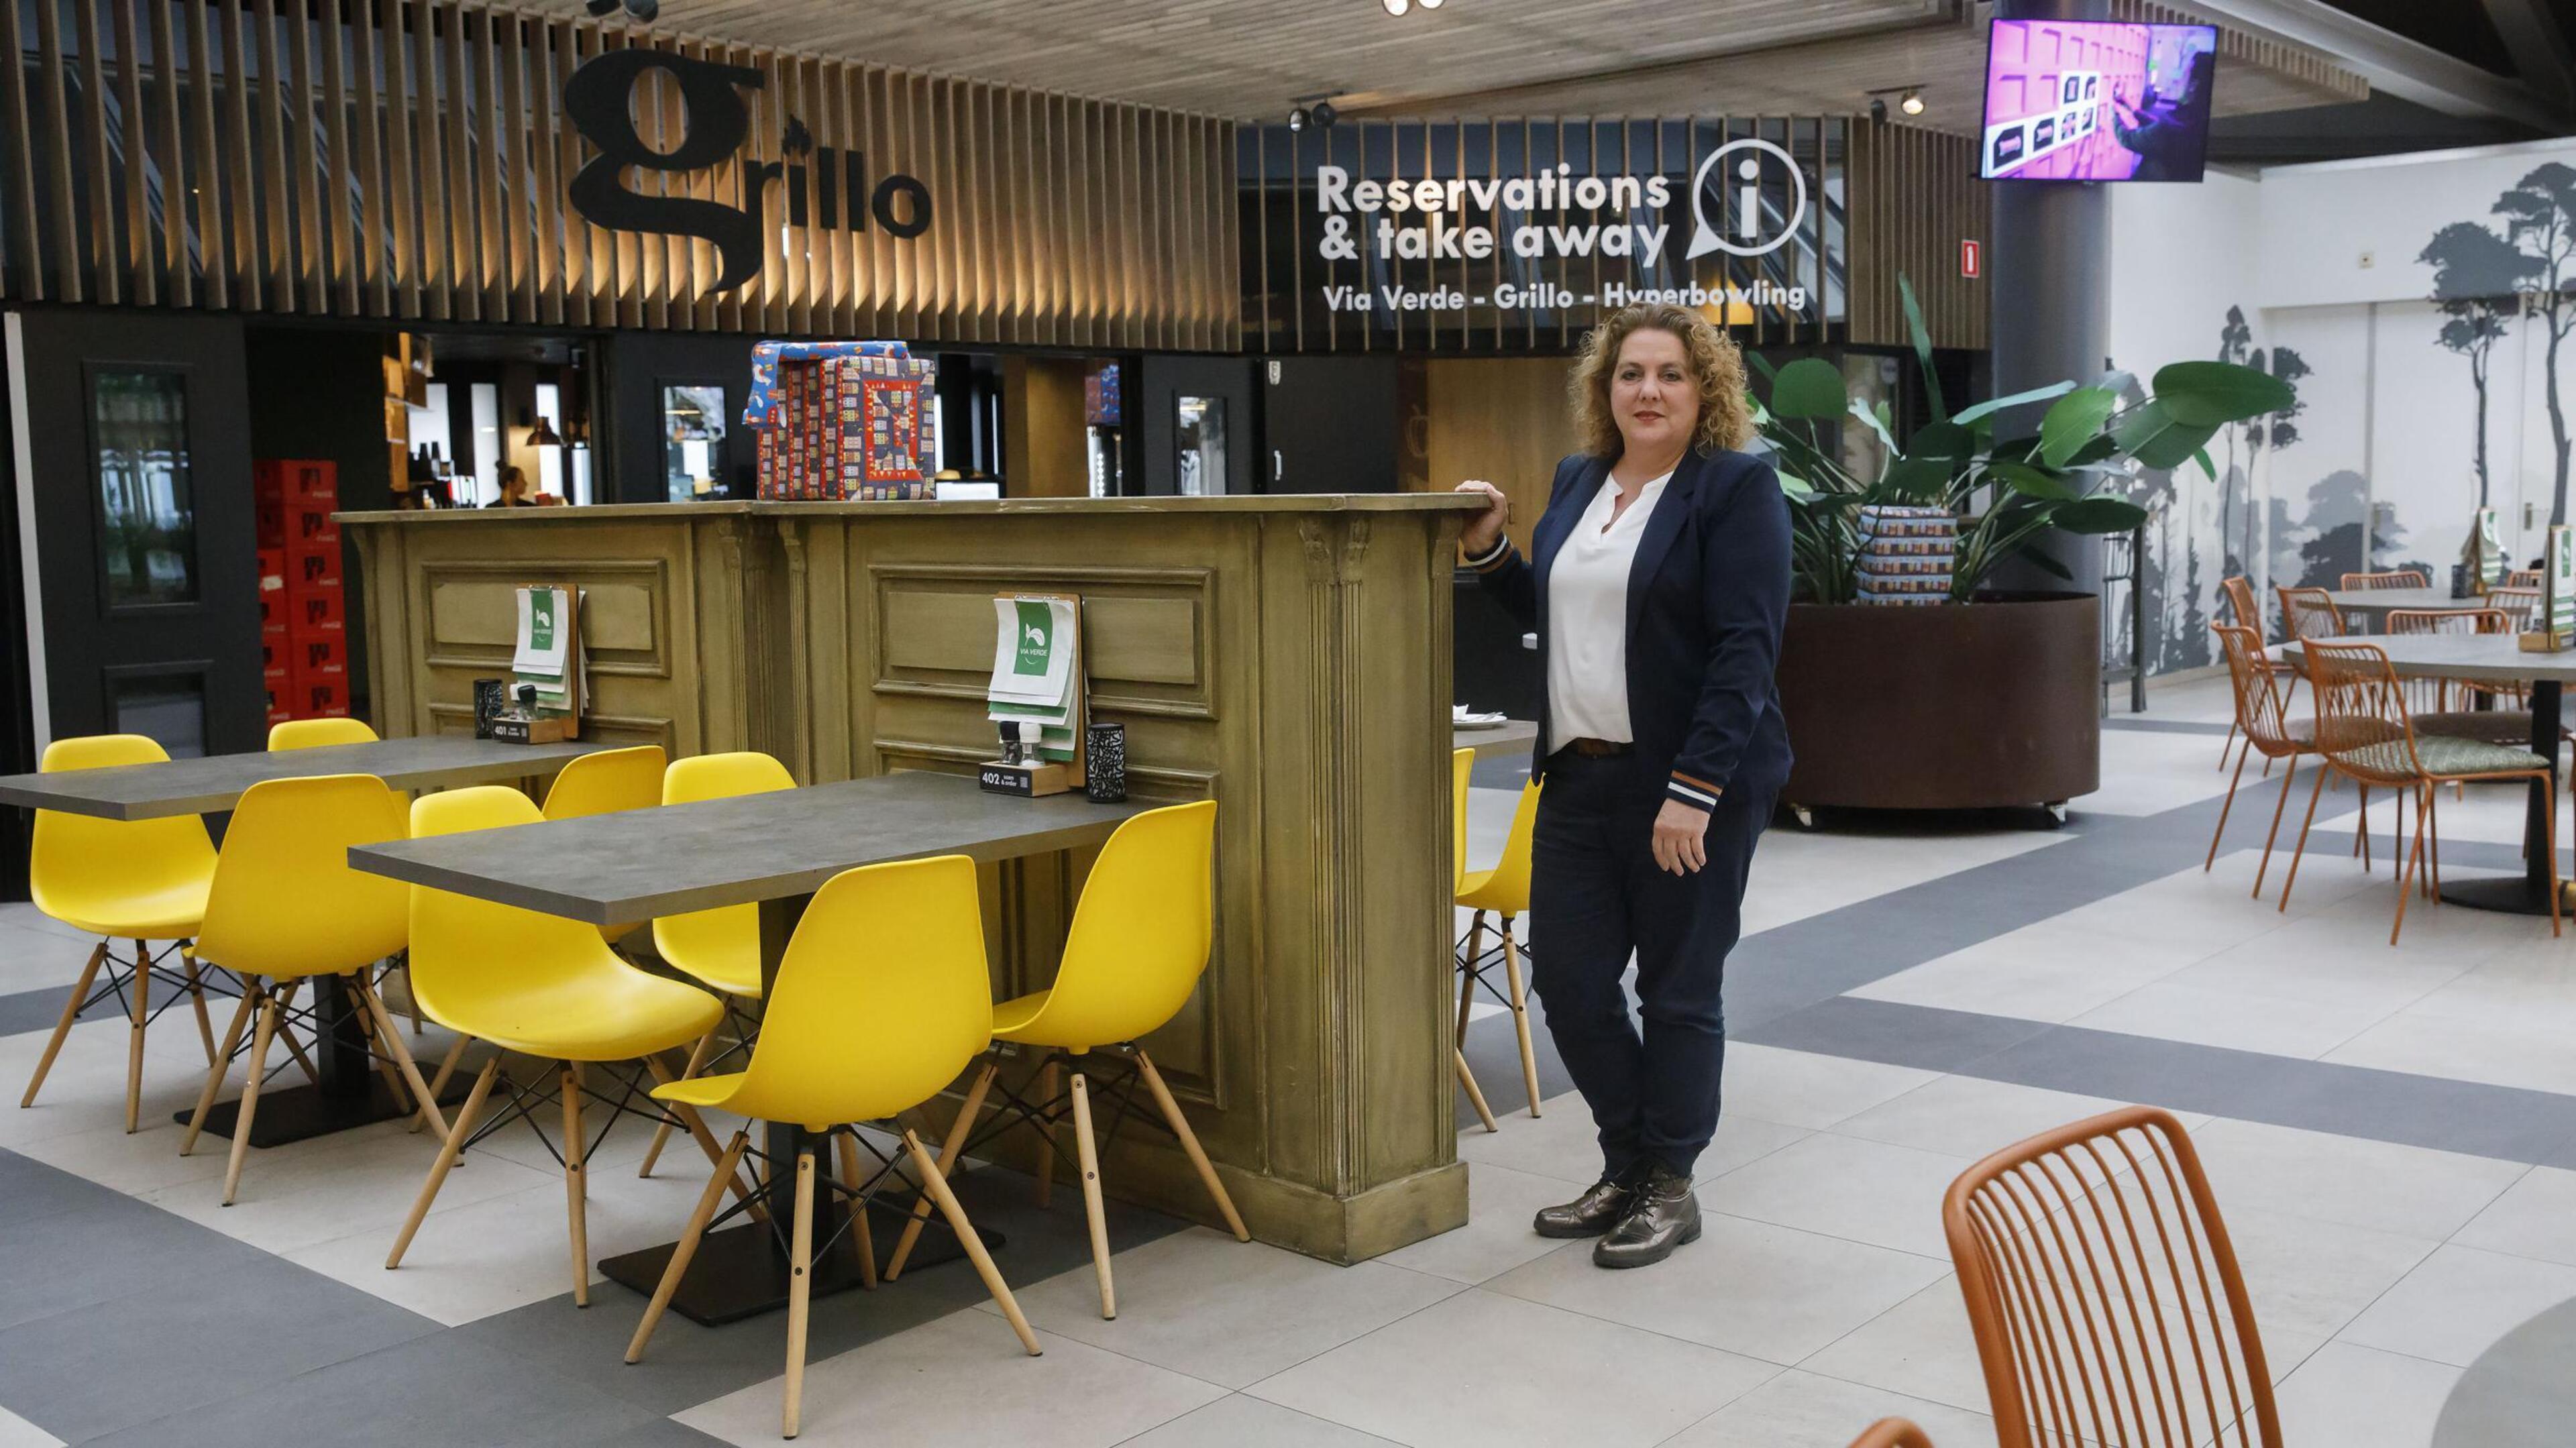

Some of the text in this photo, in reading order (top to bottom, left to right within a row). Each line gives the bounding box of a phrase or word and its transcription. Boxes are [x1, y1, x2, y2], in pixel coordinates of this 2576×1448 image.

[564, 49, 932, 294] grillo
[1318, 162, 1670, 212] Reservations
[1319, 211, 1670, 268] & take away
[1323, 286, 1371, 311] Via
[1382, 284, 1465, 311] Verde
[1494, 282, 1573, 309] Grillo
[1604, 280, 1805, 311] Hyperbowling
[982, 772, 1000, 785] 402
